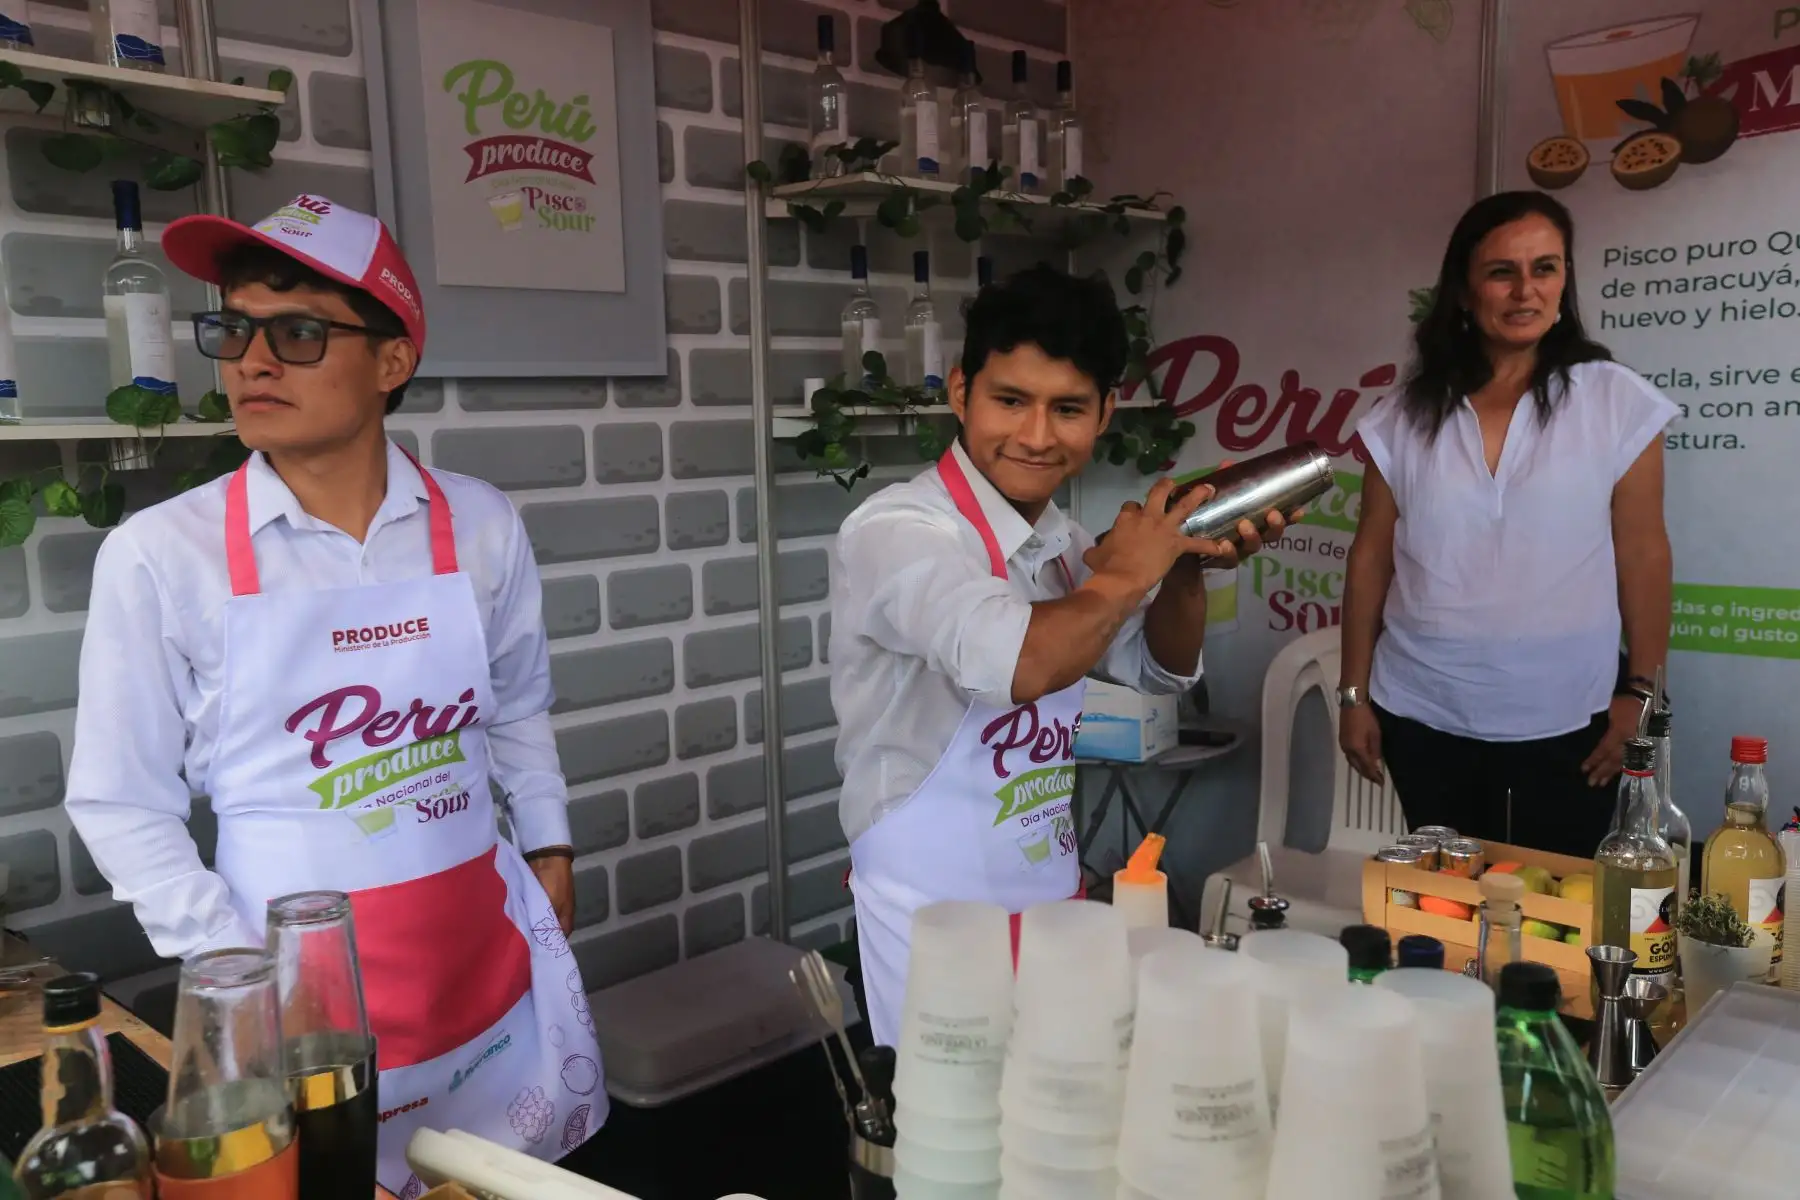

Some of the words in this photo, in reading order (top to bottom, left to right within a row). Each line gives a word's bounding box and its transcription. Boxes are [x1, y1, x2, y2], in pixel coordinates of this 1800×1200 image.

[443, 59, 597, 143] Perú
[477, 139, 584, 175] produce
[538, 206, 596, 232] Sour
[1604, 246, 1677, 267] Pisco
[1687, 238, 1757, 265] puro
[1601, 279, 1636, 299] de
[1645, 263, 1800, 297] maracuyá,
[1600, 310, 1686, 330] huevo
[1694, 307, 1711, 328] y
[1709, 364, 1780, 386] sirve
[1700, 400, 1753, 418] con
[1318, 540, 1347, 559] de
[332, 617, 430, 646] PRODUCE
[1709, 623, 1728, 638] el
[1734, 627, 1798, 643] gusto
[285, 685, 480, 769] Perú
[331, 738, 456, 808] produce
[376, 775, 433, 807] Nacional
[434, 771, 451, 784] del
[1005, 768, 1076, 816] produc
[416, 790, 471, 824] Sour
[1021, 814, 1040, 828] Día
